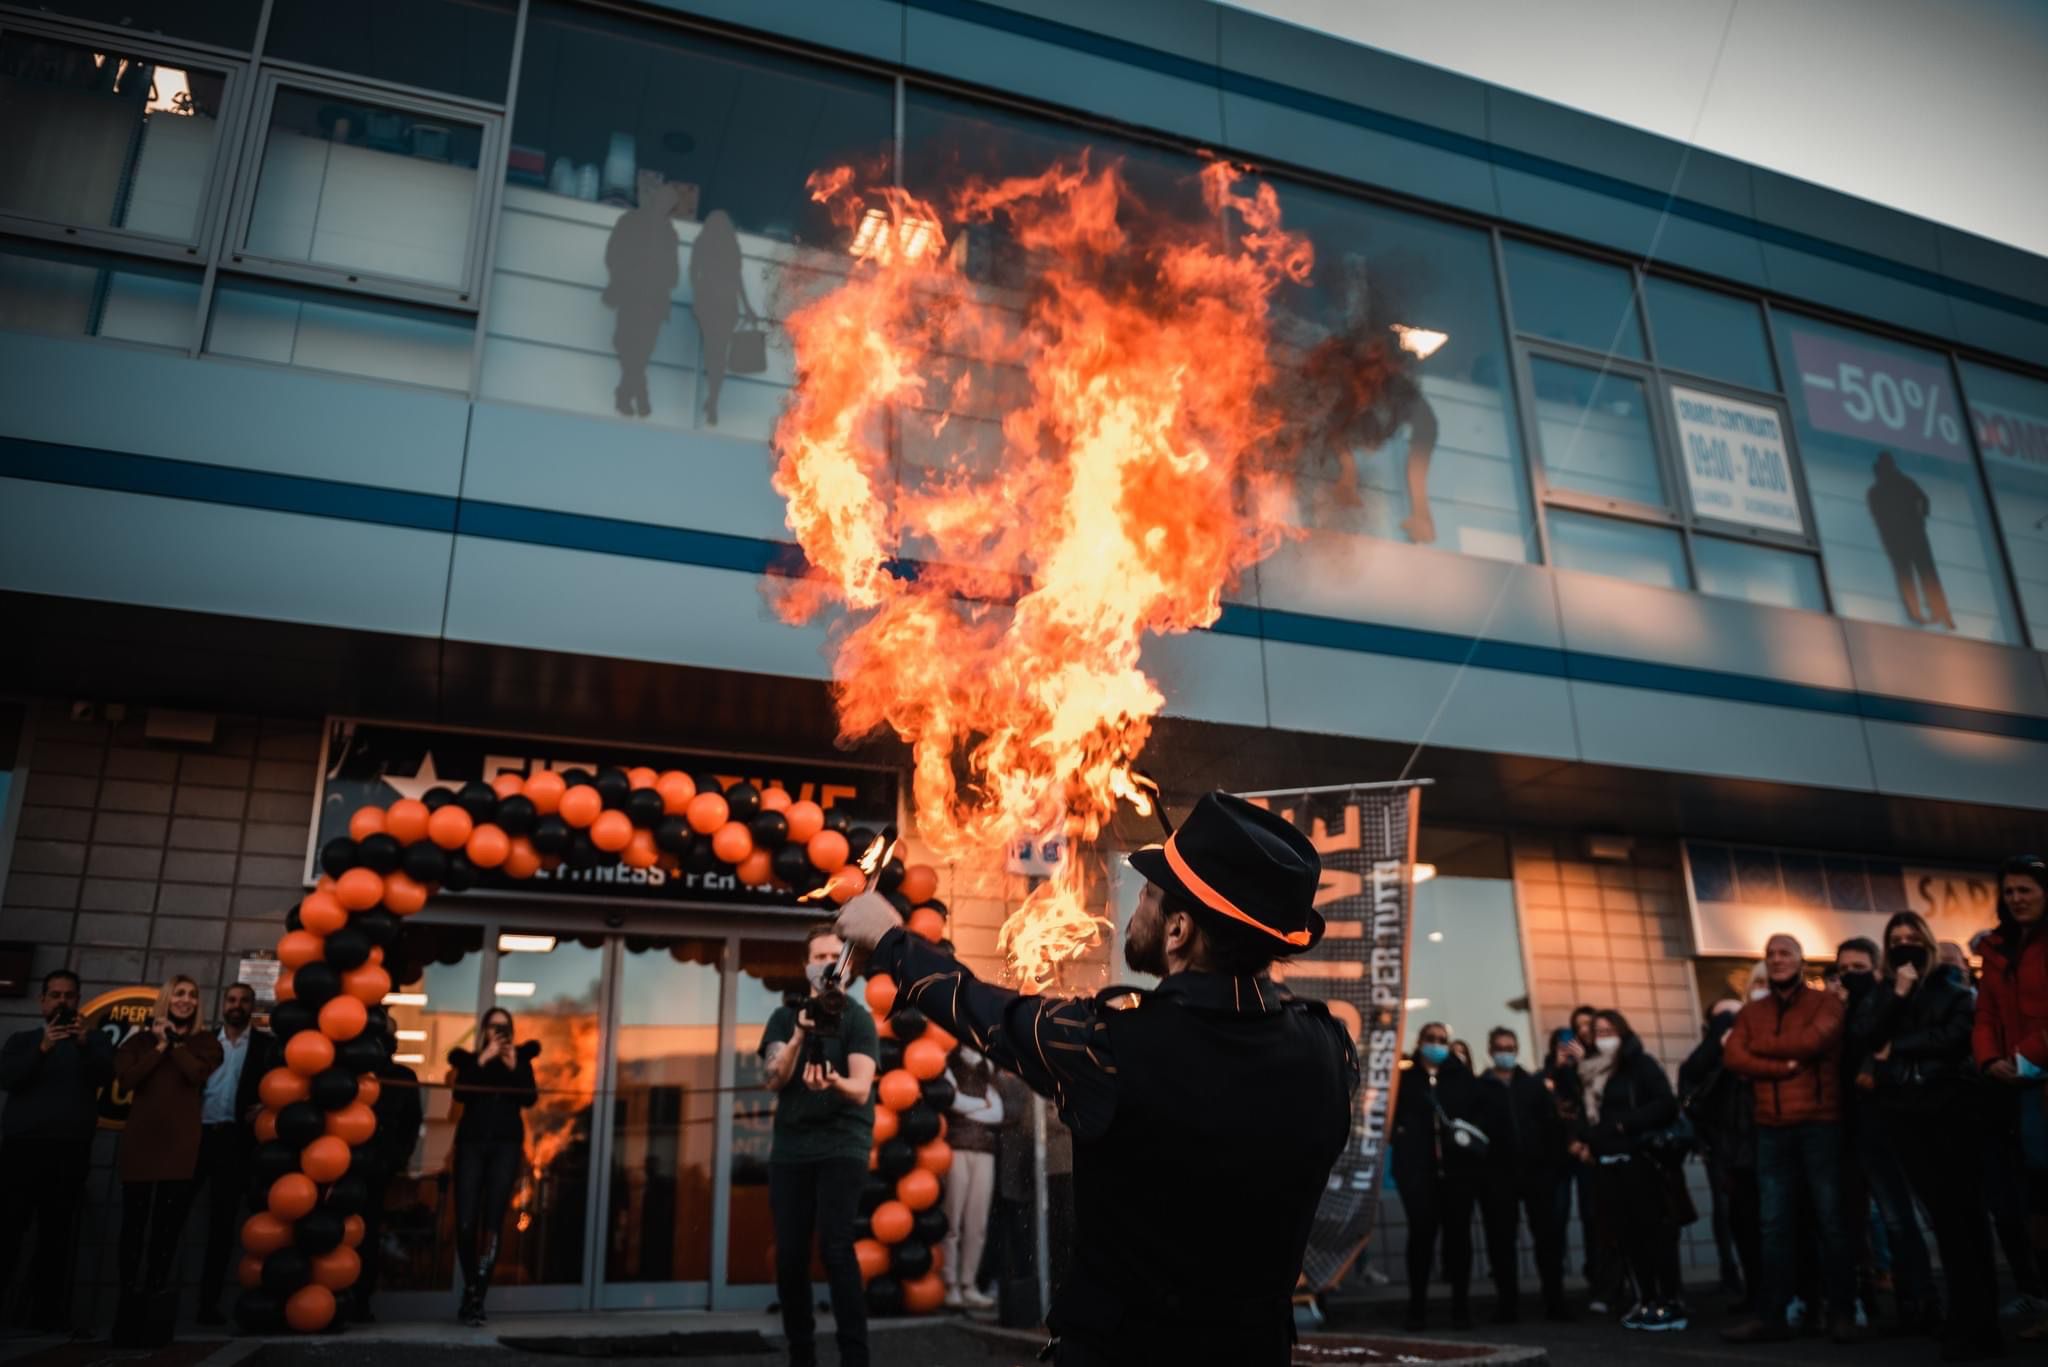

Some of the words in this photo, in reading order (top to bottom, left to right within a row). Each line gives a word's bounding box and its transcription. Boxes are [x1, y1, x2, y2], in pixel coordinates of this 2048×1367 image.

[1802, 362, 1960, 446] -50%
[1371, 858, 1402, 943] TUTTI
[1370, 945, 1402, 1007] PER
[1360, 1029, 1397, 1156] FITNESS
